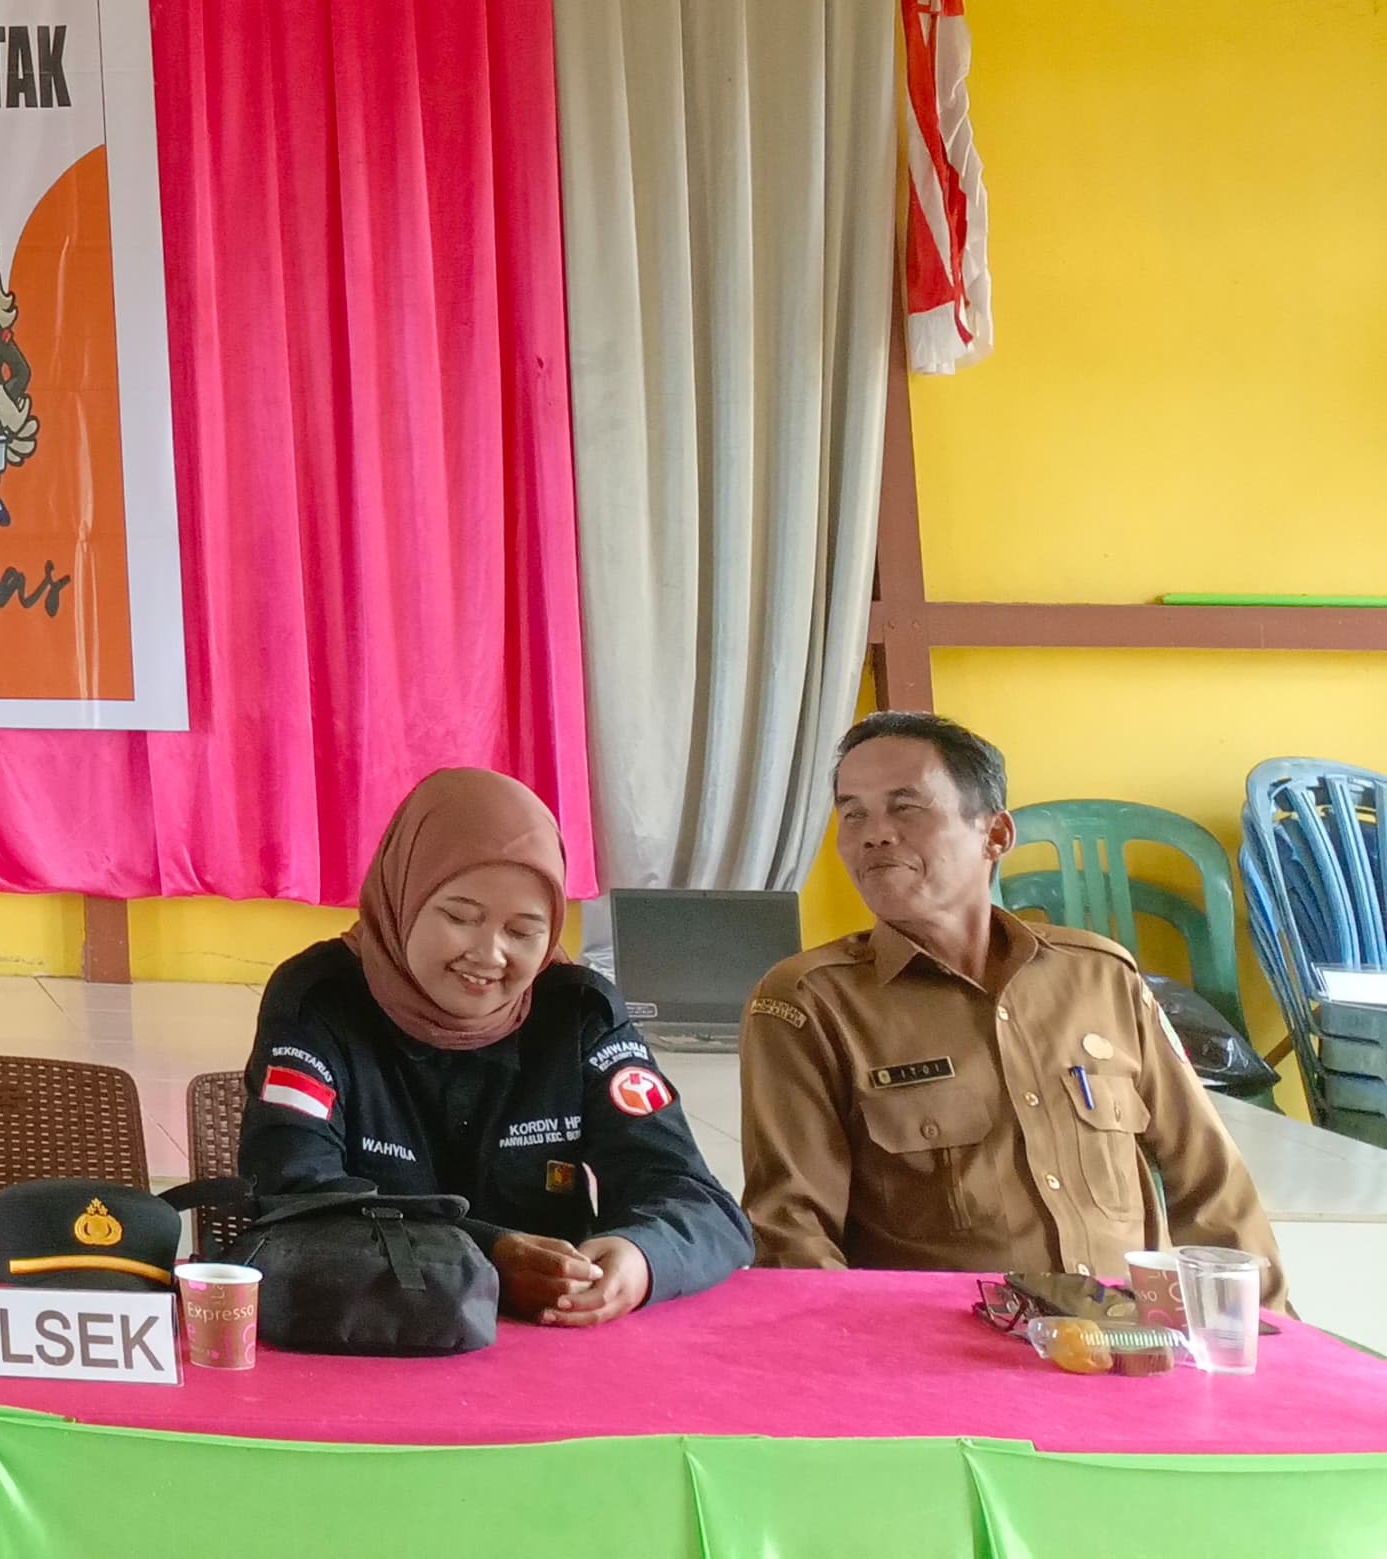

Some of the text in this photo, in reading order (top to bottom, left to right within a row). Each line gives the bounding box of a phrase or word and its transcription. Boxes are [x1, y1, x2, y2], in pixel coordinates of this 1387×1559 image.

[272, 1046, 334, 1084] SEKRETARIAT
[508, 1117, 559, 1136] KORDIV
[498, 1133, 544, 1149] PANWASLU
[187, 1301, 255, 1324] Expresso
